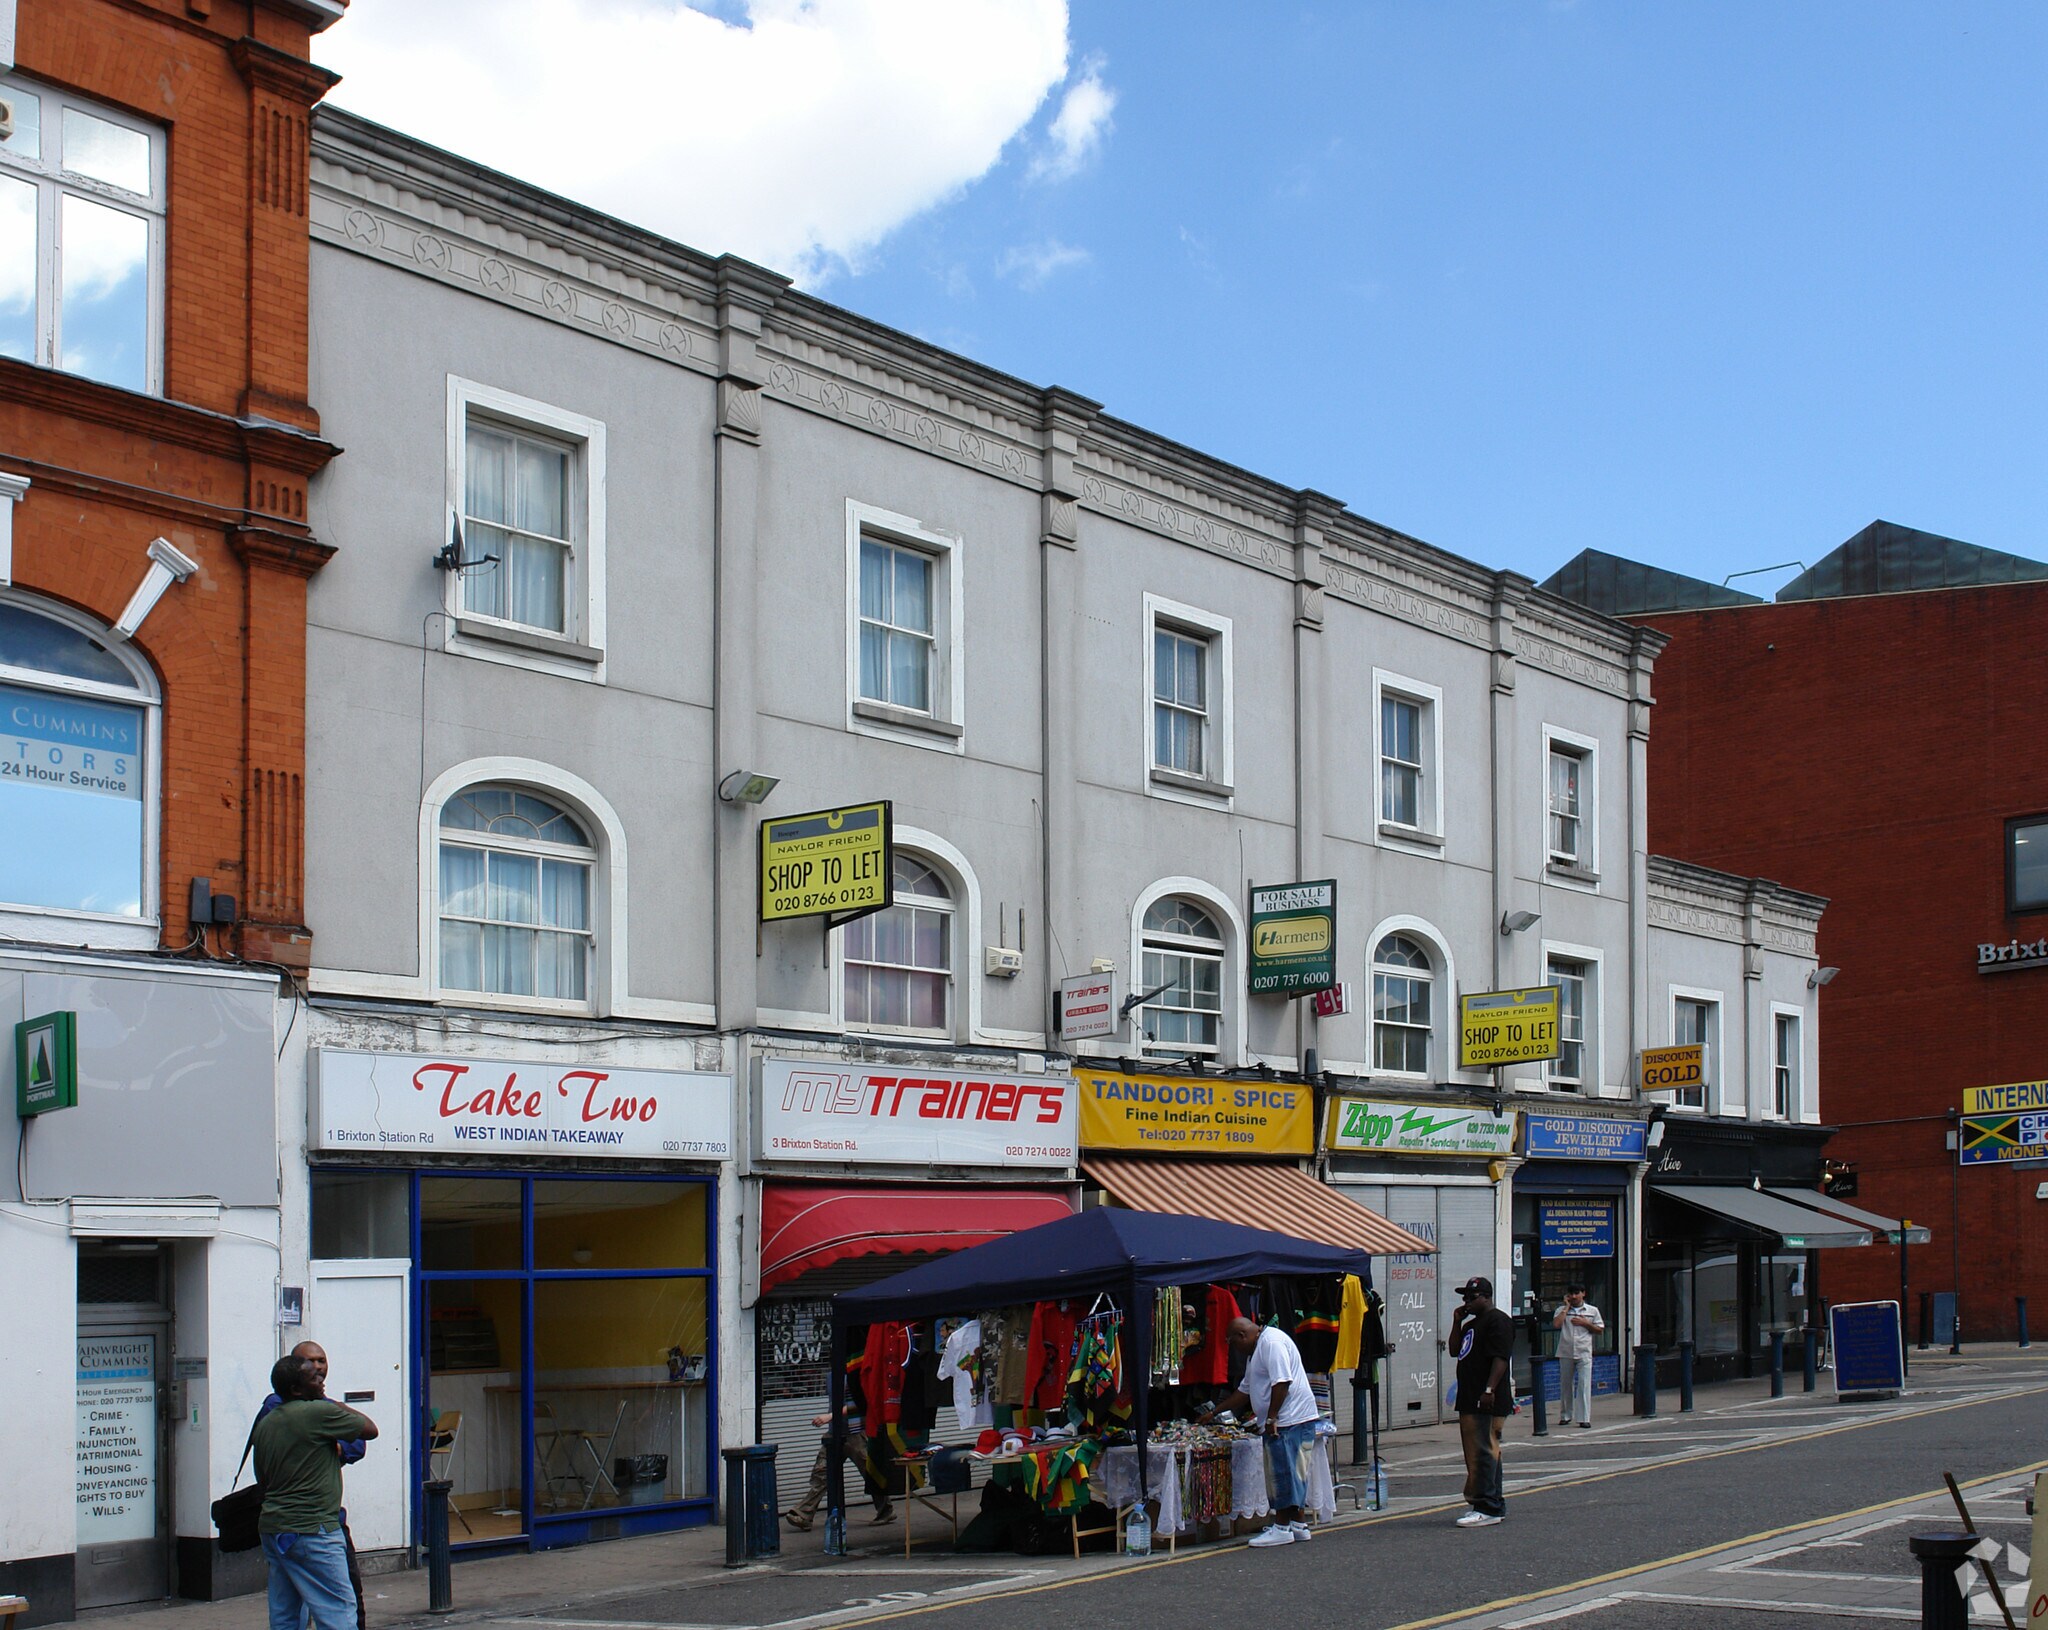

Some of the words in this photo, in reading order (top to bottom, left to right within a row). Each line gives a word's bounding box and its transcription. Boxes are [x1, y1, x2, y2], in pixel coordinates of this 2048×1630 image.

[12, 706, 128, 742] CUMMINS
[1, 761, 21, 776] 24
[26, 764, 65, 782] Hour
[69, 770, 127, 792] Service
[777, 841, 824, 854] NAYLOR
[828, 833, 872, 847] FRIEND
[768, 861, 813, 893] SHOP
[821, 857, 842, 885] TO
[853, 850, 881, 881] LET
[775, 896, 800, 911] 020
[803, 891, 836, 908] 8766
[840, 886, 874, 903] 0123
[1261, 891, 1287, 903] FOR
[1290, 887, 1325, 900] SALE
[1265, 898, 1320, 911] BUSINESS
[1259, 930, 1326, 946] Harmens
[1254, 976, 1279, 989] 0207
[1282, 974, 1300, 986] 737
[1303, 971, 1330, 985] 6000
[1067, 1008, 1087, 1016] URBAN
[1088, 1005, 1107, 1013] STORE
[1472, 1010, 1509, 1019] NAYLOR
[1512, 1006, 1548, 1015] FRIEND
[1465, 1026, 1499, 1046] SHOP
[1505, 1024, 1522, 1042] TO
[1531, 1021, 1555, 1040] LET
[1470, 1049, 1491, 1060] 020
[1493, 1047, 1519, 1058] 8766
[1522, 1044, 1550, 1056] 0123
[1645, 1050, 1701, 1065] DISCOUNT
[1645, 1064, 1701, 1085] GOLD
[413, 1063, 542, 1118] Take
[558, 1070, 658, 1123] Two
[1091, 1080, 1213, 1105] TANDOORI
[1233, 1089, 1296, 1110] SPICE
[1976, 1083, 2048, 1110] INTERN
[1125, 1107, 1159, 1122] Fine
[1164, 1109, 1210, 1124] Indian
[1214, 1112, 1267, 1126] Cuisine
[1341, 1102, 1394, 1146] Zipp
[454, 1125, 496, 1141] WEST
[500, 1127, 548, 1142] INDIAN
[551, 1129, 625, 1145] TAKEAWAY
[1545, 1119, 1575, 1132] GOLD
[1578, 1121, 1632, 1135] DISCOUNT
[327, 1129, 334, 1142] 1
[337, 1129, 376, 1143] Brixton
[379, 1131, 418, 1144] Station
[419, 1131, 434, 1144] Rd
[772, 1138, 779, 1149] 3
[781, 1138, 812, 1150] Brixton
[813, 1139, 843, 1151] Station
[844, 1139, 858, 1151] Rd.
[1190, 1130, 1220, 1142] 7737
[1225, 1131, 1255, 1143] 1809
[1399, 1136, 1424, 1147] Repairs
[1430, 1138, 1460, 1150] Servicing
[1466, 1139, 1497, 1151] Unlocking
[1555, 1133, 1623, 1147] JEWELLERY
[663, 1140, 680, 1152] 020
[681, 1141, 704, 1152] 7737
[705, 1141, 727, 1153] 7803
[1006, 1146, 1023, 1156] 020
[1025, 1146, 1048, 1157] 7274
[1049, 1147, 1072, 1157] 0022
[1657, 1147, 1682, 1172] Hive
[1391, 1268, 1412, 1280] BEST
[1415, 1267, 1435, 1280] DEAL
[80, 1355, 149, 1368] CUMMINS
[773, 1342, 822, 1365] NOW
[89, 1411, 123, 1422] CRIME
[89, 1425, 126, 1436] FAMILY
[76, 1437, 137, 1449] INJUNCTION
[84, 1463, 132, 1476] HOUSING
[109, 1491, 122, 1500] TO
[125, 1489, 145, 1499] BUY
[92, 1506, 124, 1517] WILLS
